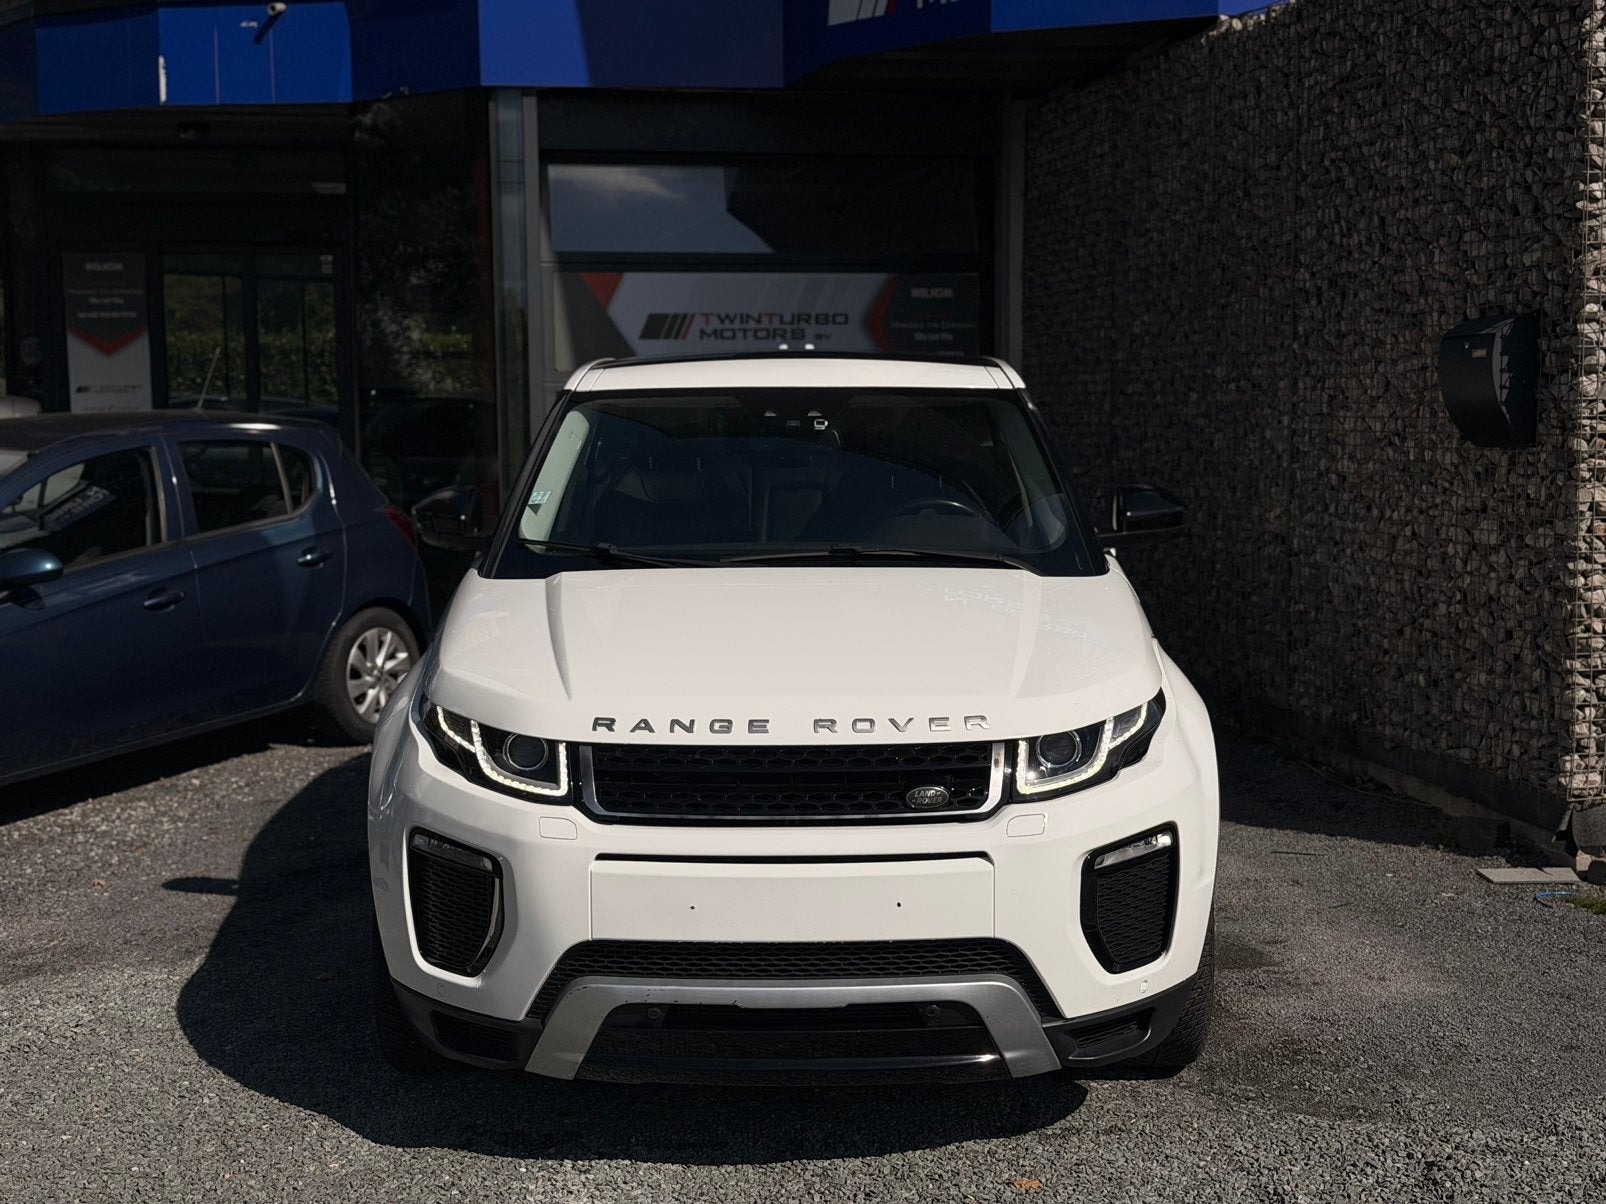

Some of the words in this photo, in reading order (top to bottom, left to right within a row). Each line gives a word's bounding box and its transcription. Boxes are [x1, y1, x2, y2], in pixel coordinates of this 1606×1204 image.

[699, 312, 849, 326] TWINTURBO
[699, 327, 806, 341] MOTORS
[591, 716, 771, 734] RANGE
[812, 714, 991, 734] ROVER
[914, 790, 936, 798] LAND
[917, 797, 943, 805] ROVER
